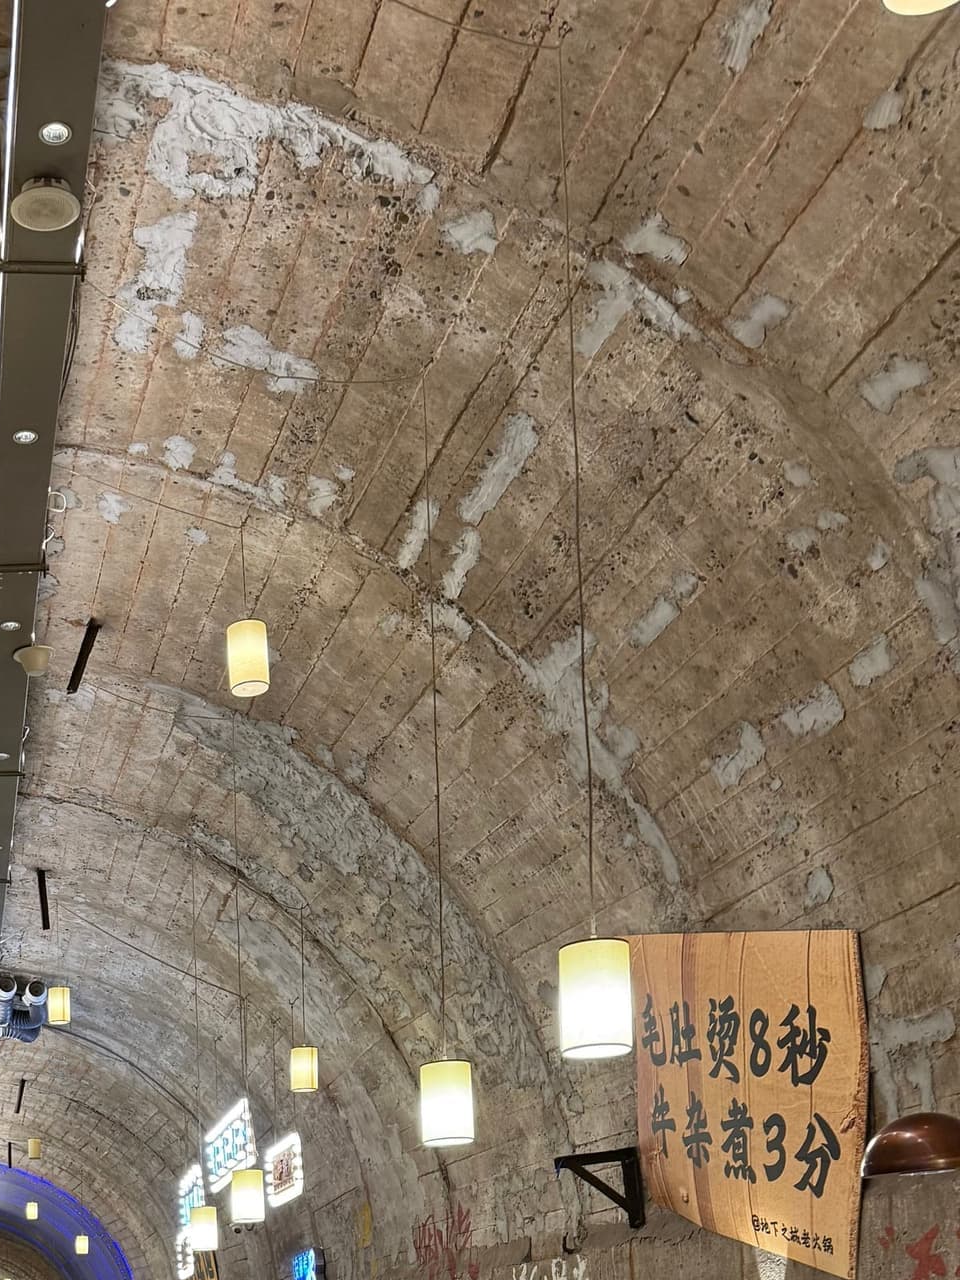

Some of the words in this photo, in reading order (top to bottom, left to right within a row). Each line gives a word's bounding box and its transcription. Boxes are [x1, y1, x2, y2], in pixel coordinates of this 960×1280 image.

[641, 993, 832, 1086] 毛肚烫8秒
[650, 1083, 841, 1199] 牛杂煮3分
